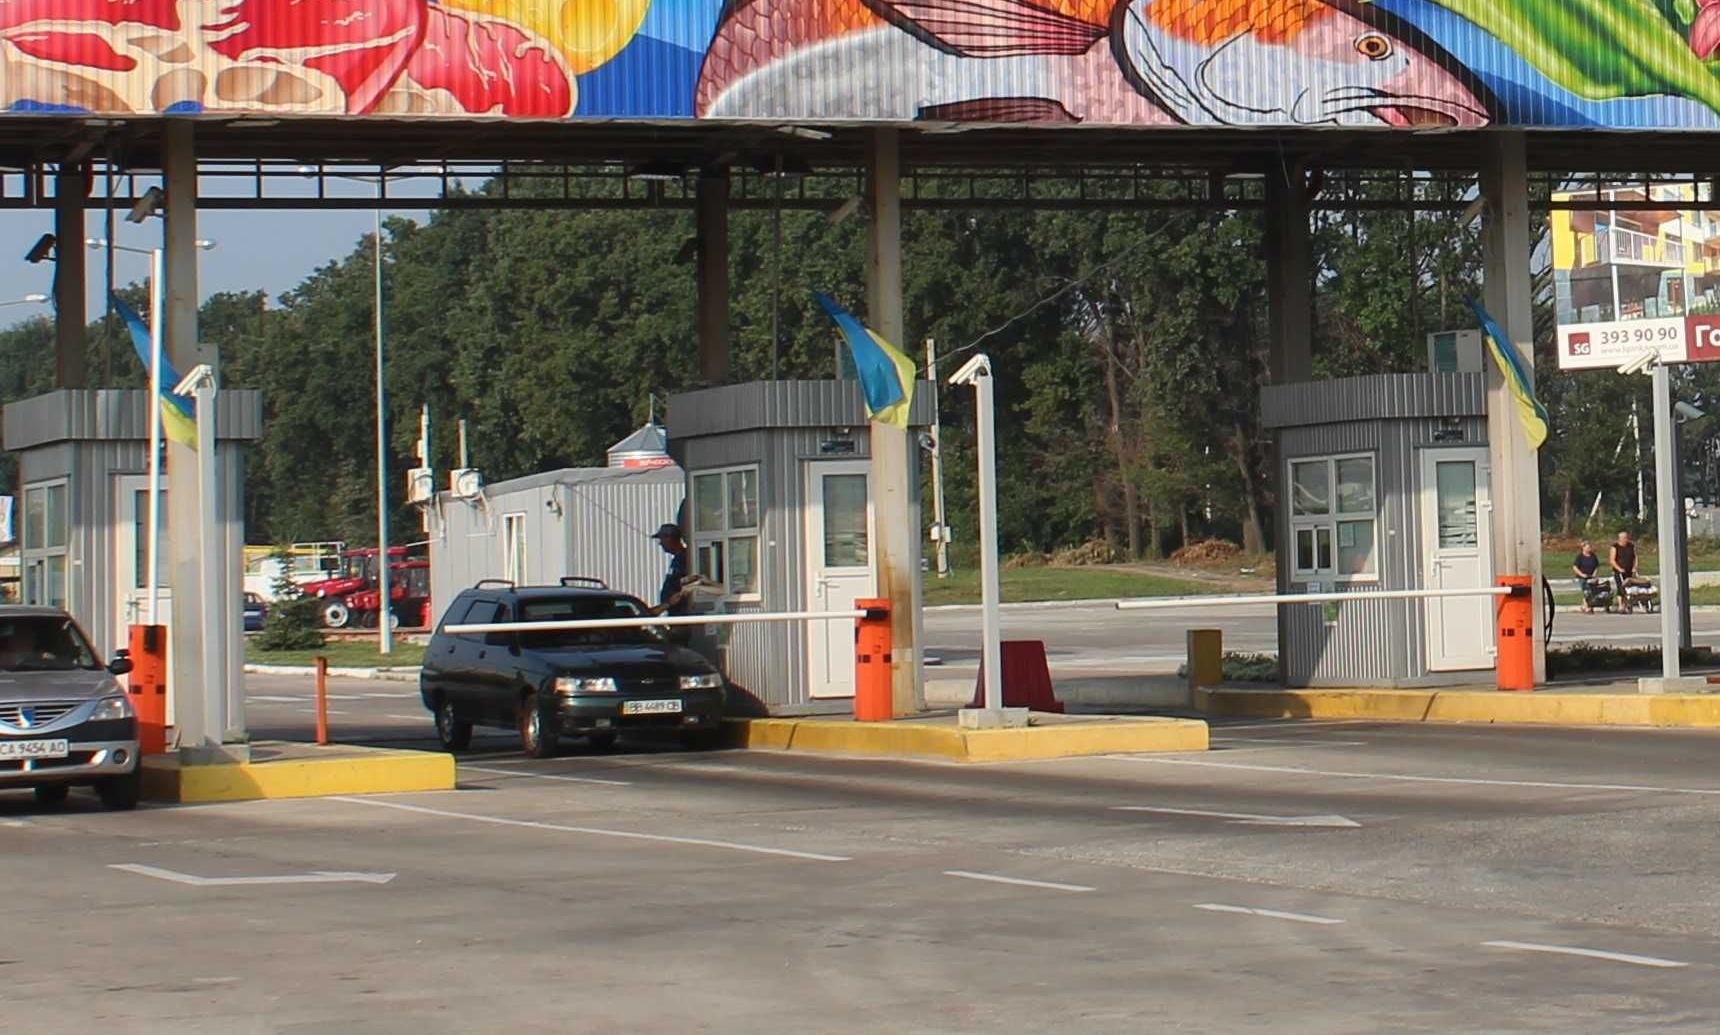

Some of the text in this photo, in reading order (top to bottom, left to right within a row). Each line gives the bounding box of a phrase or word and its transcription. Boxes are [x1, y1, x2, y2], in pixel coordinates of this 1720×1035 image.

[1601, 326, 1678, 345] 393 90 90
[1574, 342, 1590, 355] SG
